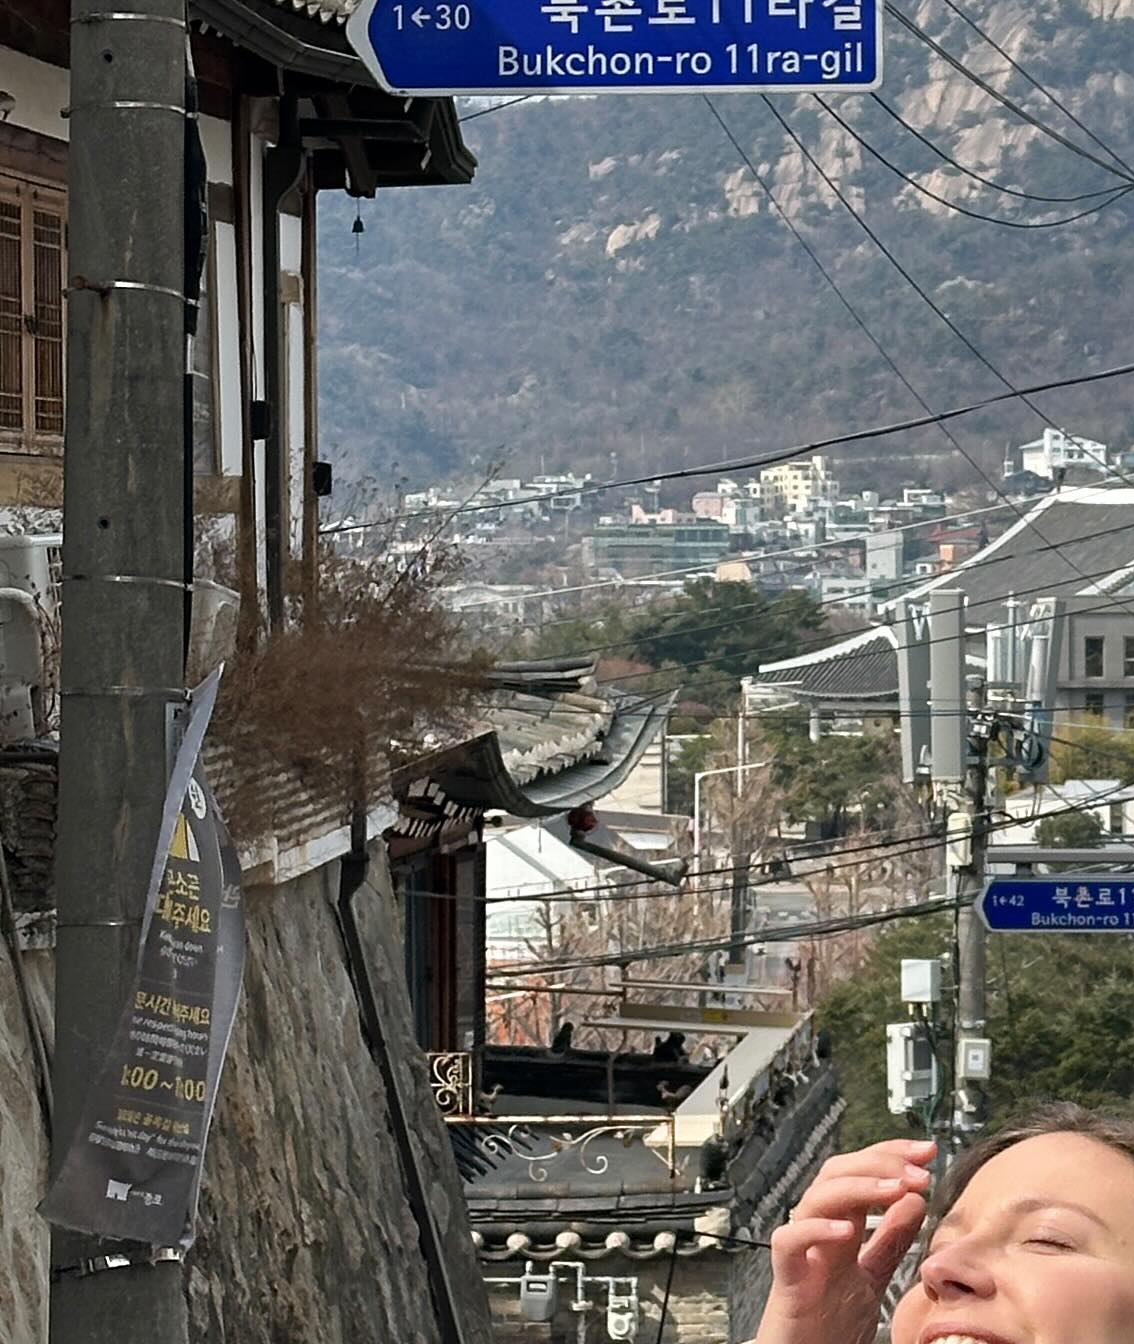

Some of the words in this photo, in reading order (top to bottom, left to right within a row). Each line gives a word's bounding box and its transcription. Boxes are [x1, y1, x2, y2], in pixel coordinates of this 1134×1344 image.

[393, 5, 403, 30] 1
[435, 4, 470, 30] 30
[498, 45, 712, 76] Bukchon-ro
[726, 42, 862, 80] 11ra-gil
[1009, 895, 1024, 906] 42
[1031, 912, 1119, 926] Bukchon-ro
